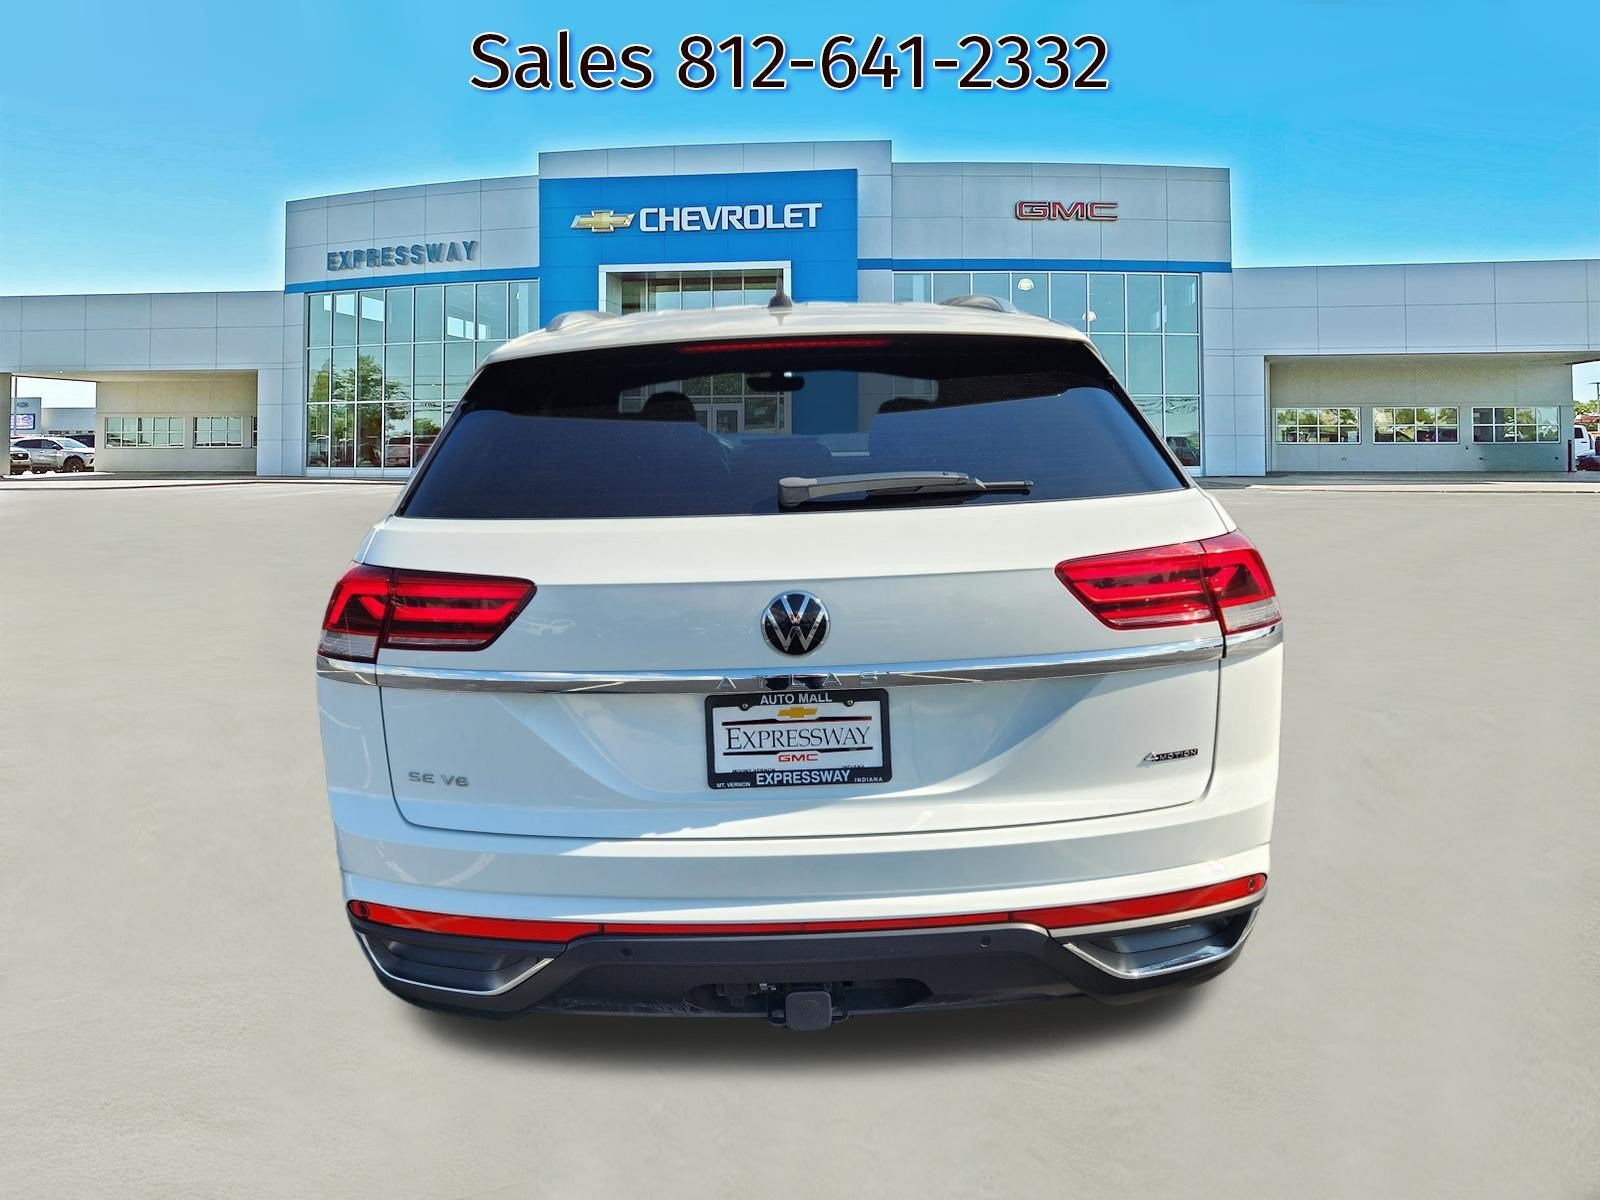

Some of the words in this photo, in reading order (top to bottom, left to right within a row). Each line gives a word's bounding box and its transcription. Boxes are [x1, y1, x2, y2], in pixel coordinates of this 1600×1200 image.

[639, 202, 823, 232] CHEVROLET
[1015, 200, 1119, 220] GMC
[326, 240, 479, 271] EXPRESSWAY
[760, 694, 795, 705] AUTO
[798, 692, 833, 703] MALL
[725, 726, 871, 750] EXPRESSWAY
[778, 753, 819, 762] GMC
[408, 771, 435, 784] SE
[756, 770, 851, 785] EXPRESSWAY
